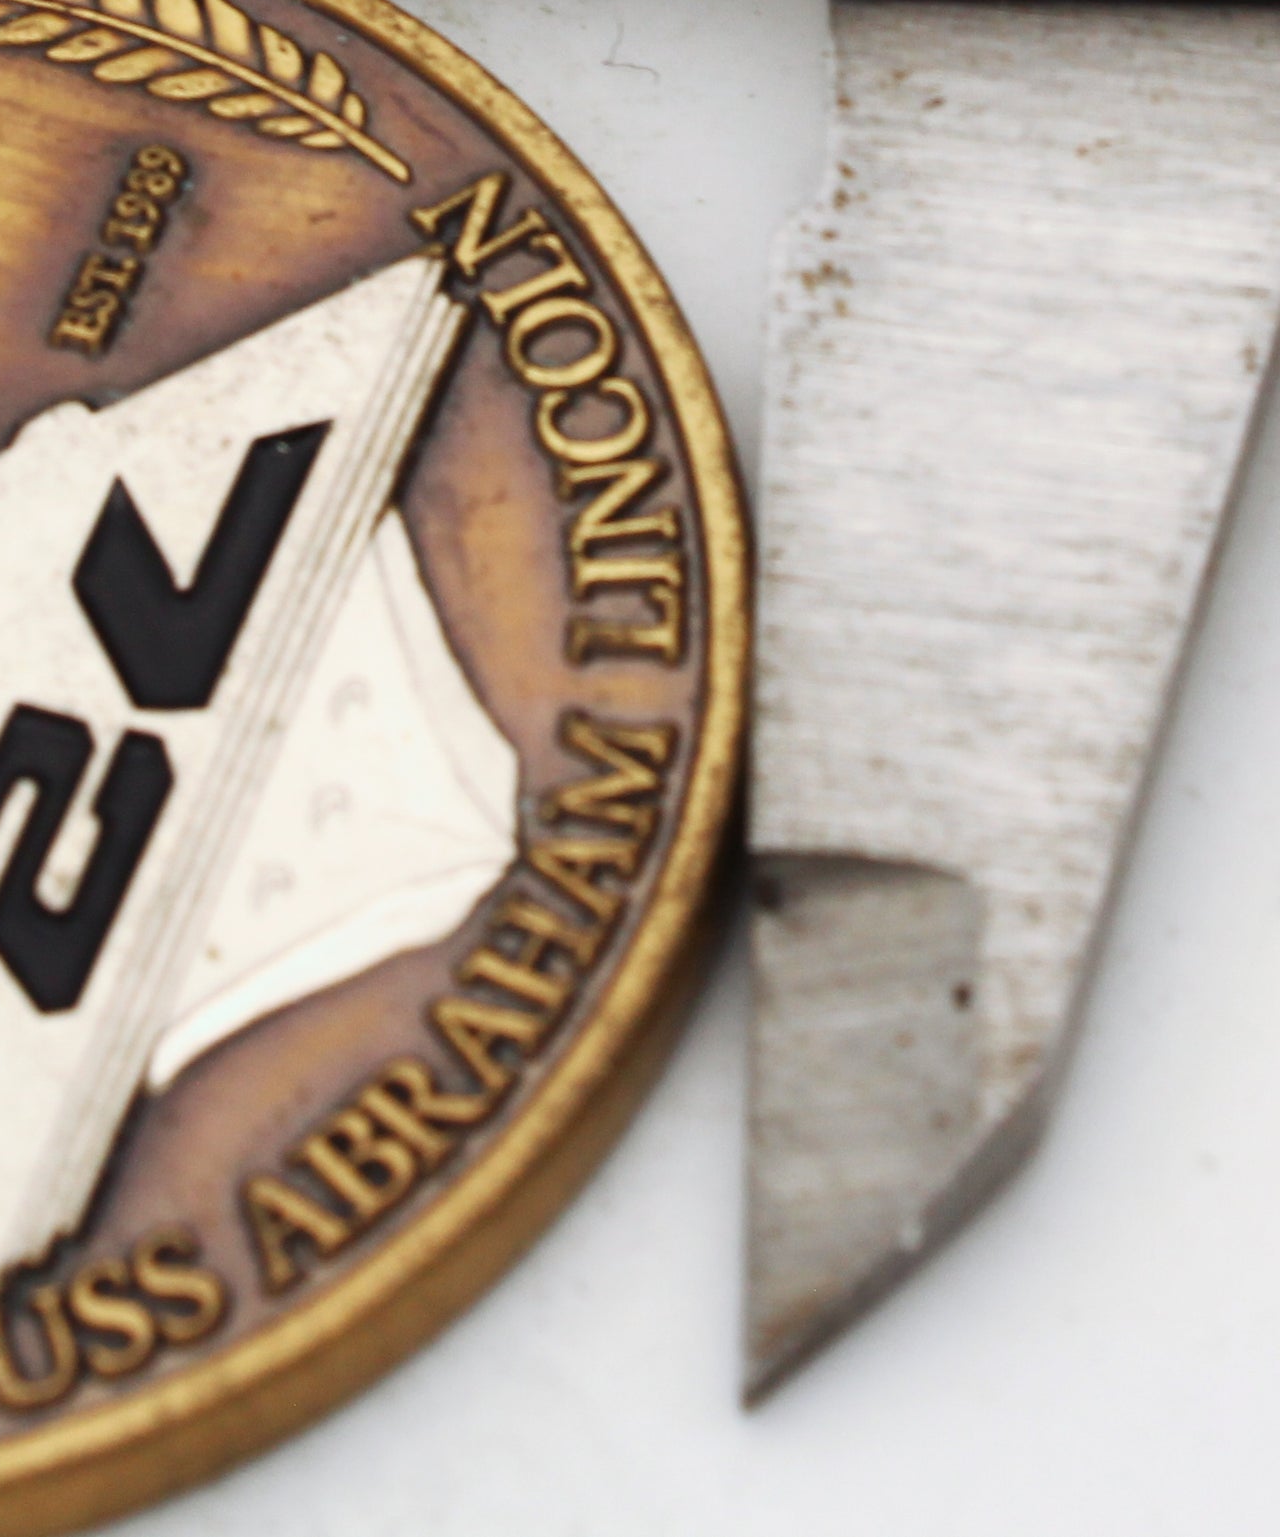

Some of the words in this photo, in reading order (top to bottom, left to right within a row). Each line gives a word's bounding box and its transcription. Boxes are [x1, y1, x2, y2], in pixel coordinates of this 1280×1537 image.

[50, 251, 138, 352] EST.
[104, 143, 184, 254] 1989
[409, 172, 686, 668] LINCOLN
[240, 711, 678, 1293] ABRAHAM
